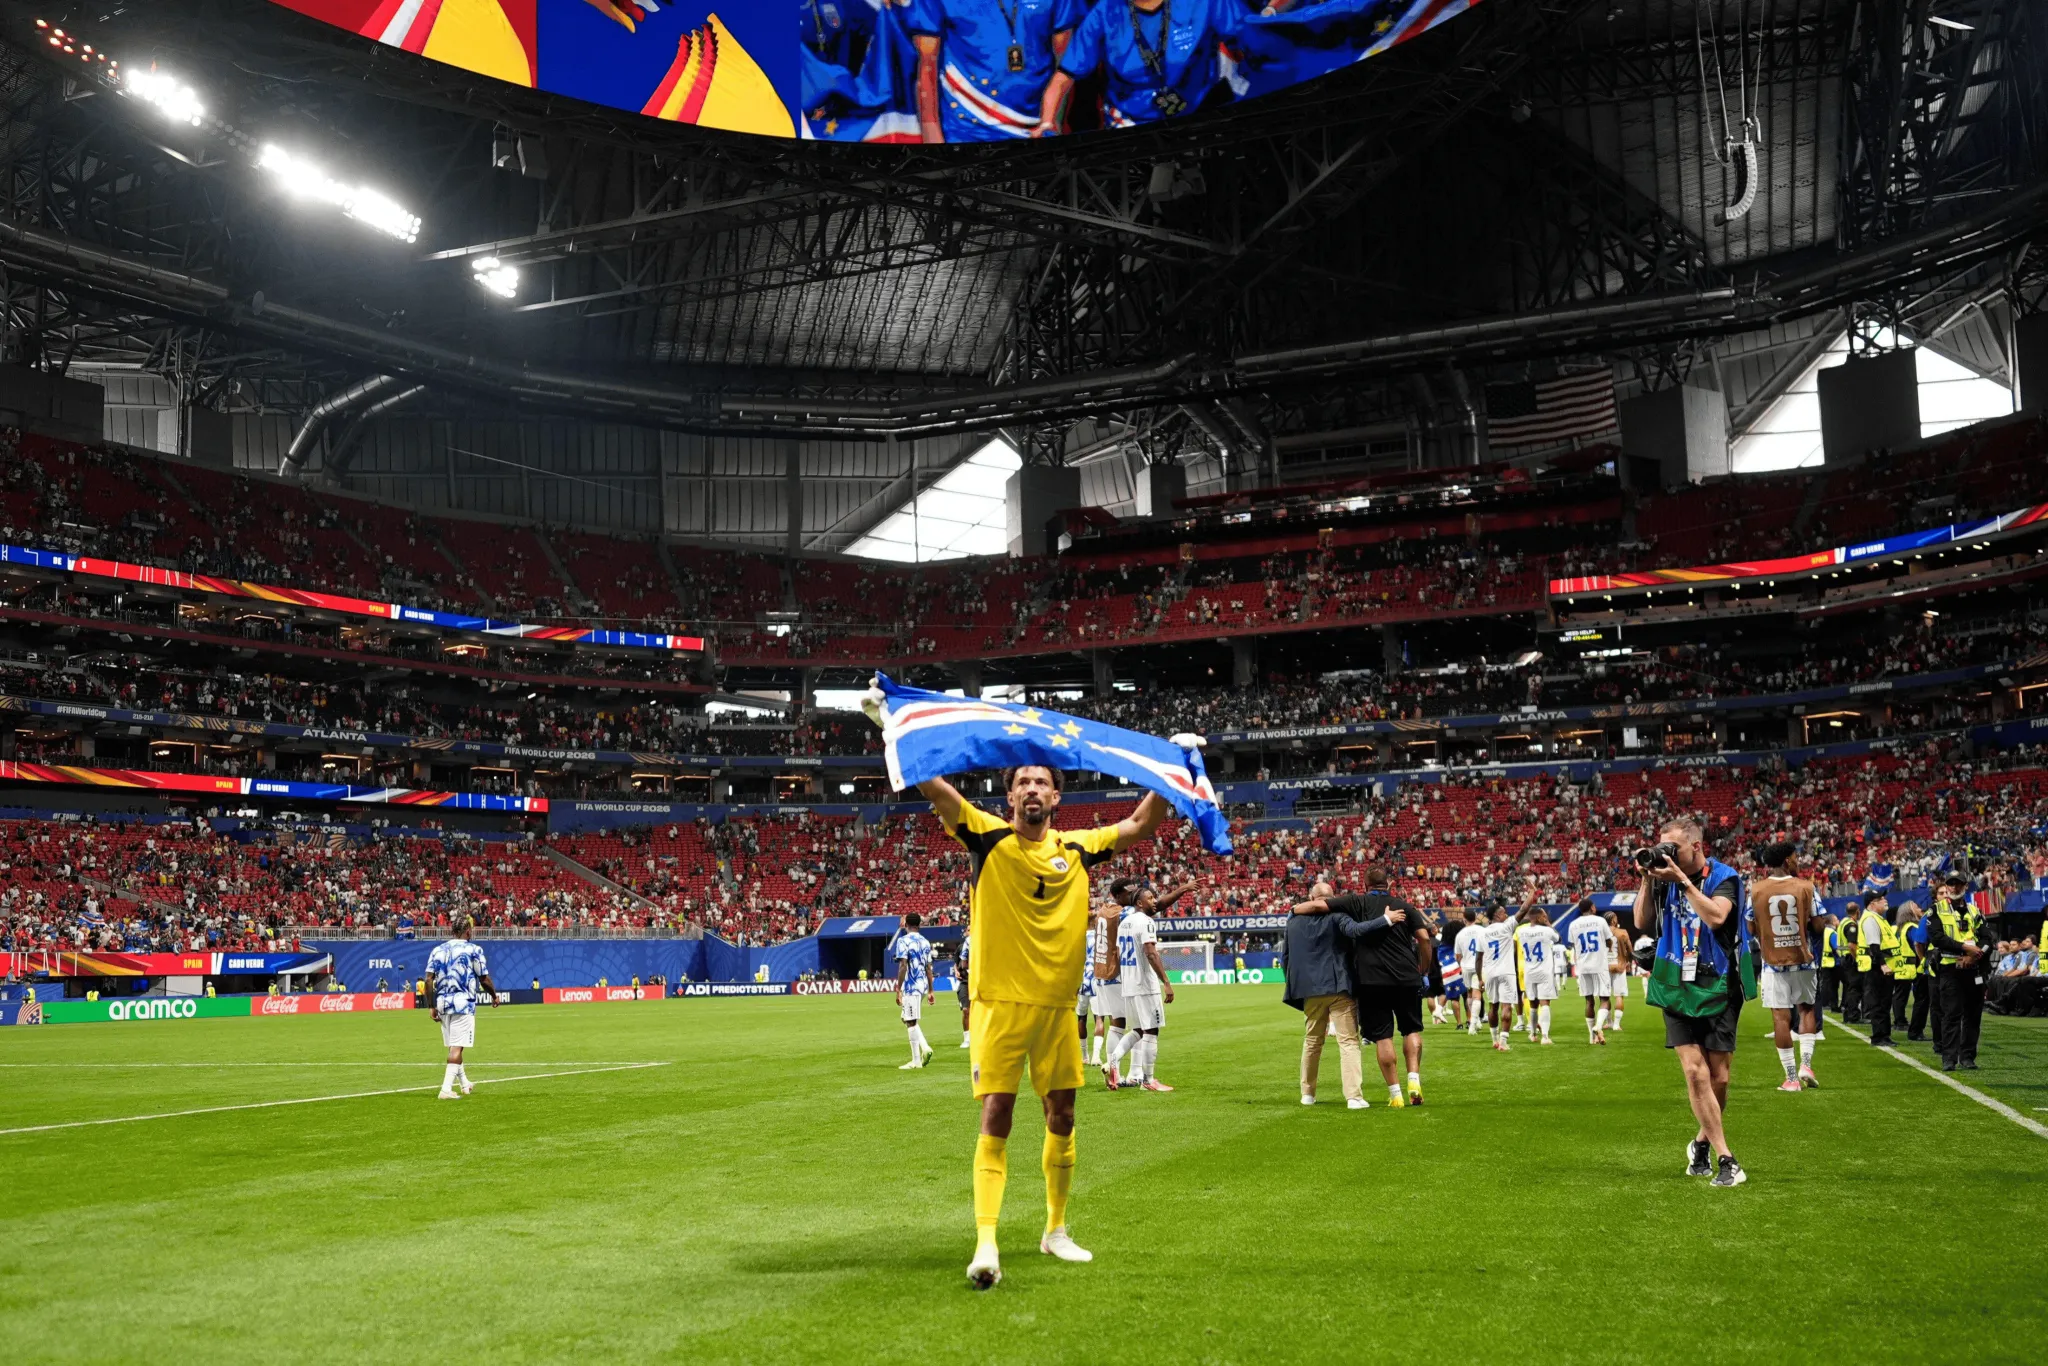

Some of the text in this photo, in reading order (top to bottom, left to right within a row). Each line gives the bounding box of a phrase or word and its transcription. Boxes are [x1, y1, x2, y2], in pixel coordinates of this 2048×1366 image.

[1850, 546, 1867, 557] CABO
[1867, 543, 1885, 555] VERDE
[404, 609, 418, 619] CABO
[418, 611, 434, 622] VERDE
[57, 705, 107, 719] #FIFAWorldCup
[1499, 711, 1568, 723] ATLANTA
[302, 728, 368, 742] ATLANTA
[1247, 726, 1347, 740] FIFA WORLD CUP 2026
[504, 746, 596, 760] FIFA WORLD CUP 2026
[1655, 755, 1728, 768] ATANTA
[215, 780, 234, 789] SPAIN
[256, 783, 271, 792] CABO
[271, 783, 290, 793] VERDE
[1268, 779, 1333, 790] ATLANTA
[575, 802, 671, 813] FIFA WORLD CUP 2026
[1033, 875, 1046, 900] 1
[1155, 916, 1288, 931] IFA WORLD CUP 2026
[1468, 938, 1477, 957] 4
[1578, 930, 1600, 954] 15
[1774, 940, 1802, 948] 2026
[1118, 935, 1136, 966] 22
[1488, 940, 1500, 961] 7
[1522, 941, 1544, 962] 14
[183, 958, 203, 969] SPAIN
[228, 958, 245, 969] CABO
[245, 958, 264, 969] VERDE
[368, 958, 393, 969] FIFA
[1181, 968, 1264, 985] aramco
[559, 988, 593, 1002] Lenovo
[685, 984, 787, 995] ADI PREDICTSTREET
[796, 980, 899, 996] QATAR AIRWAY
[108, 999, 198, 1021] aramco
